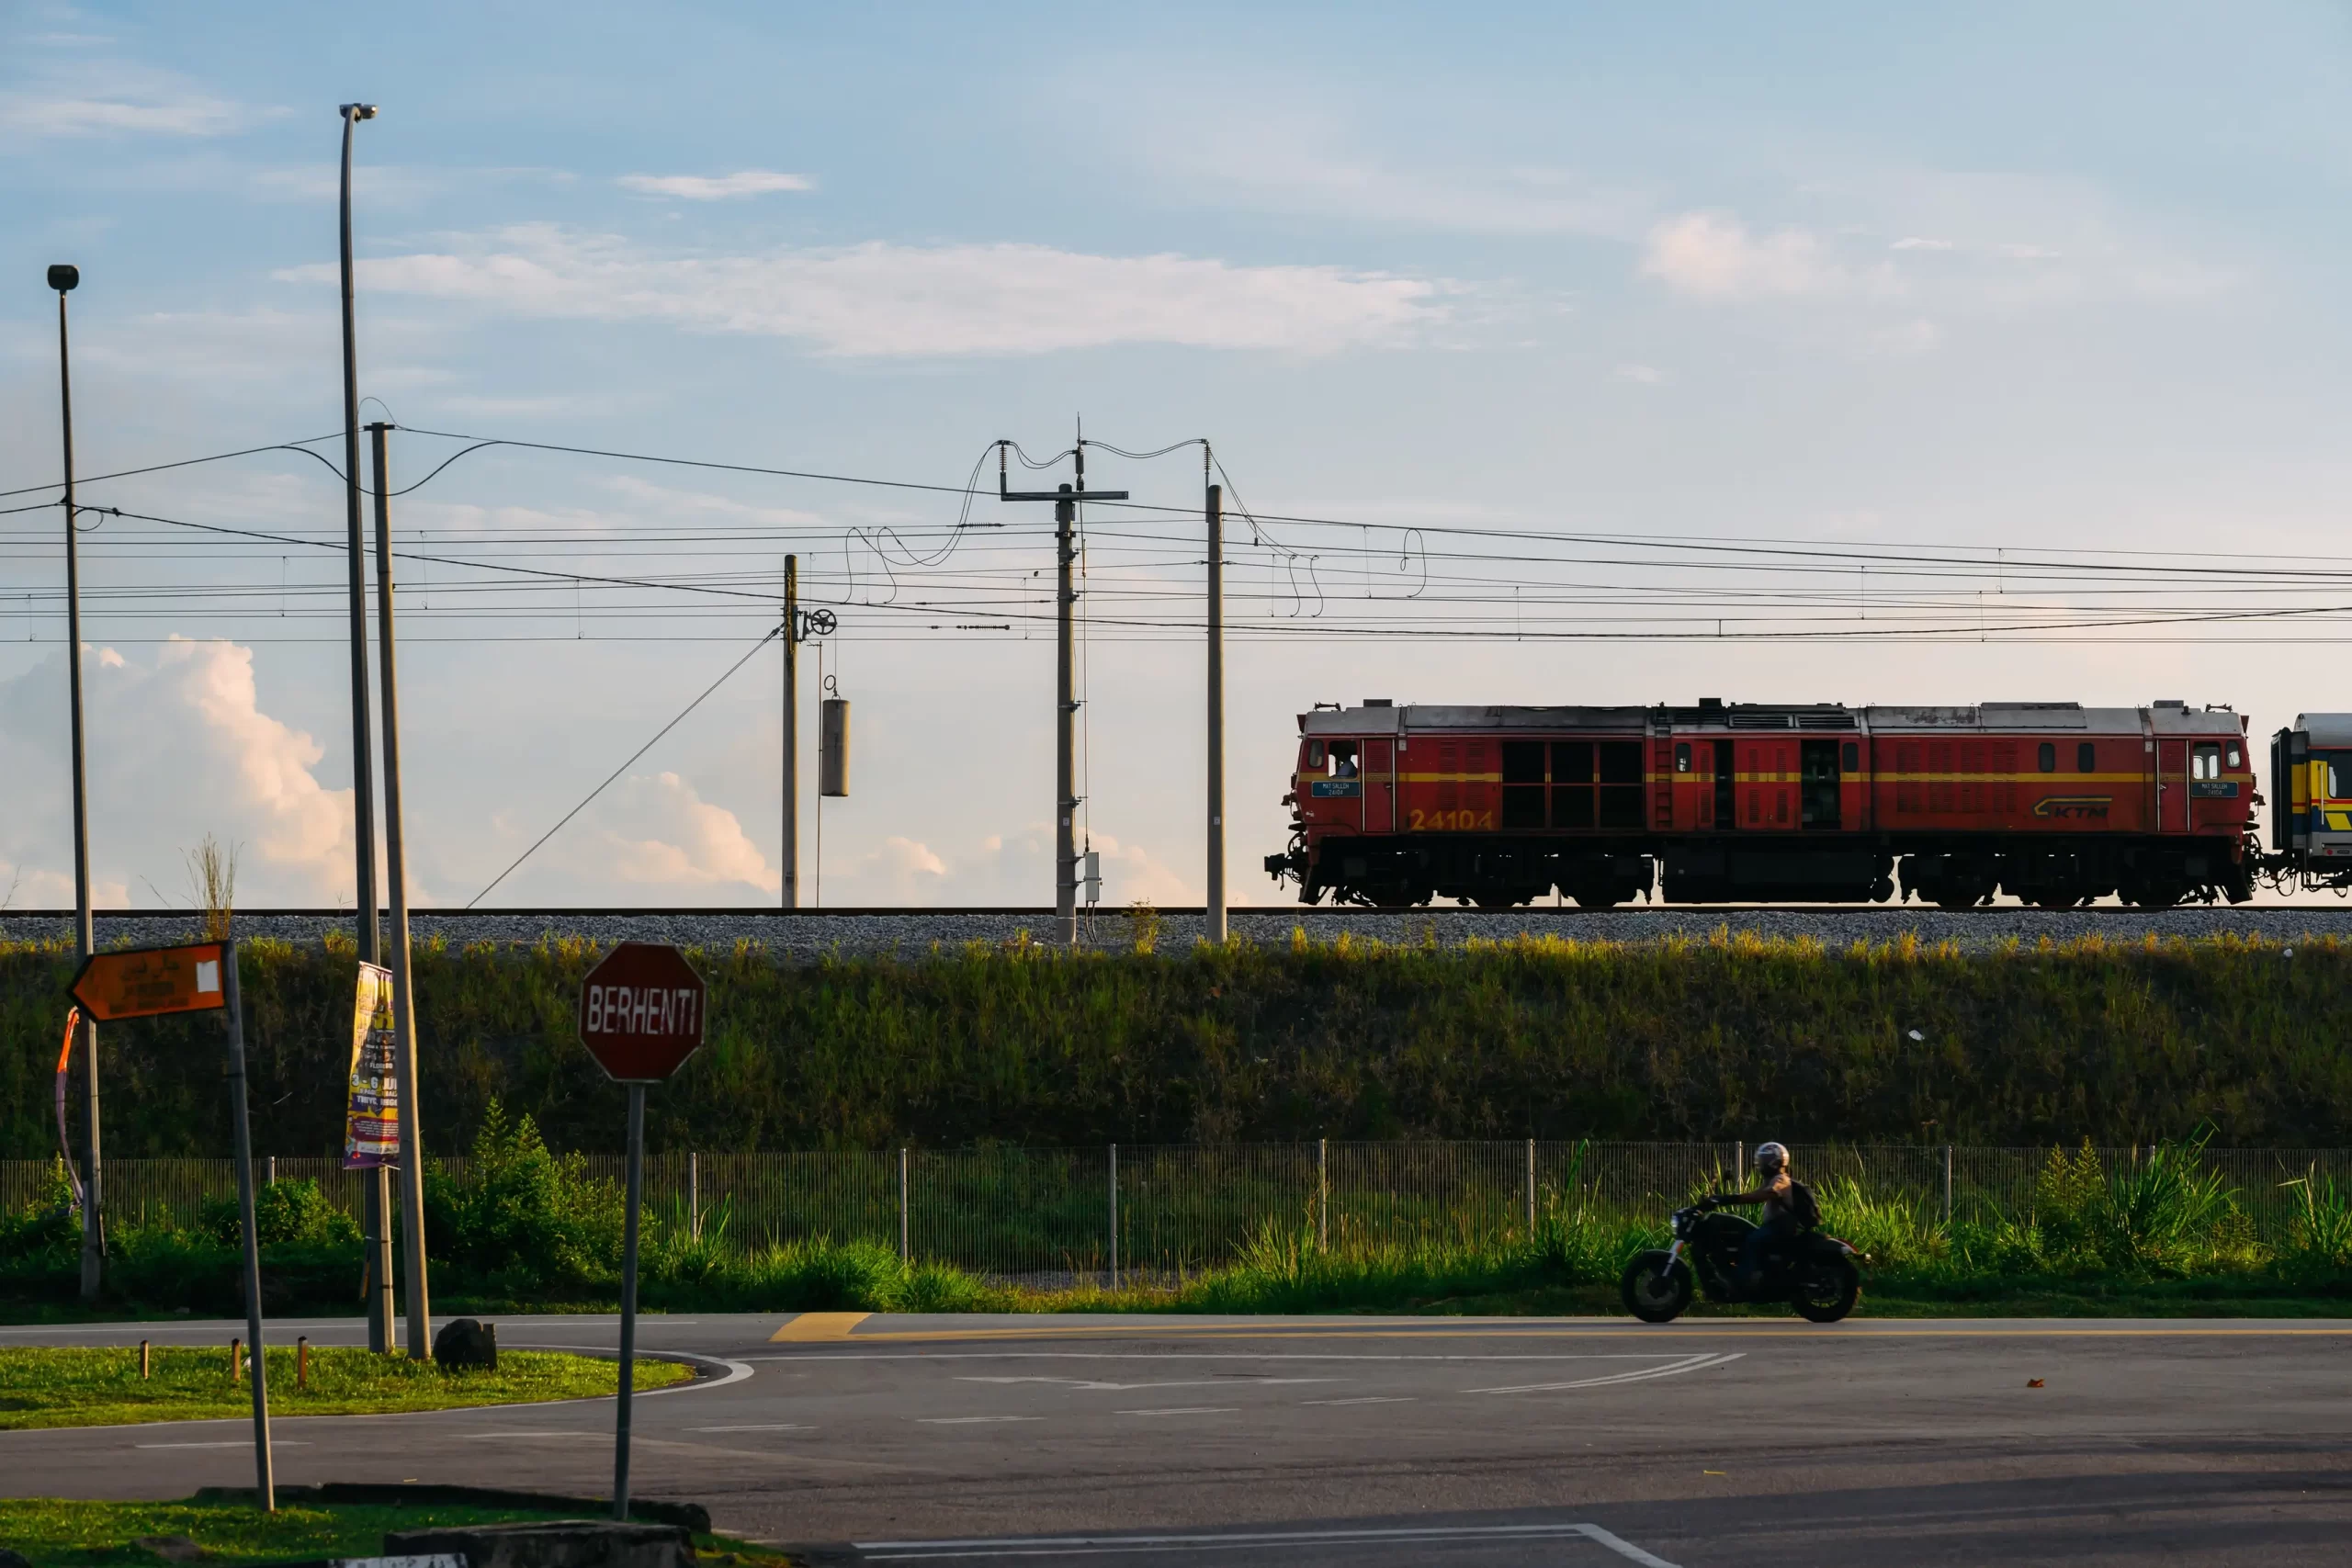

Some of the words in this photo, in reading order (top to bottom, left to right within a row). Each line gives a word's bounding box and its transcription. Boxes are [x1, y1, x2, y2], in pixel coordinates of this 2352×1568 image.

[1409, 809, 1493, 830] 24104
[2054, 807, 2109, 818] KTM
[586, 985, 697, 1035] BERHENTI
[351, 1074, 359, 1087] 3
[370, 1077, 379, 1089] 6
